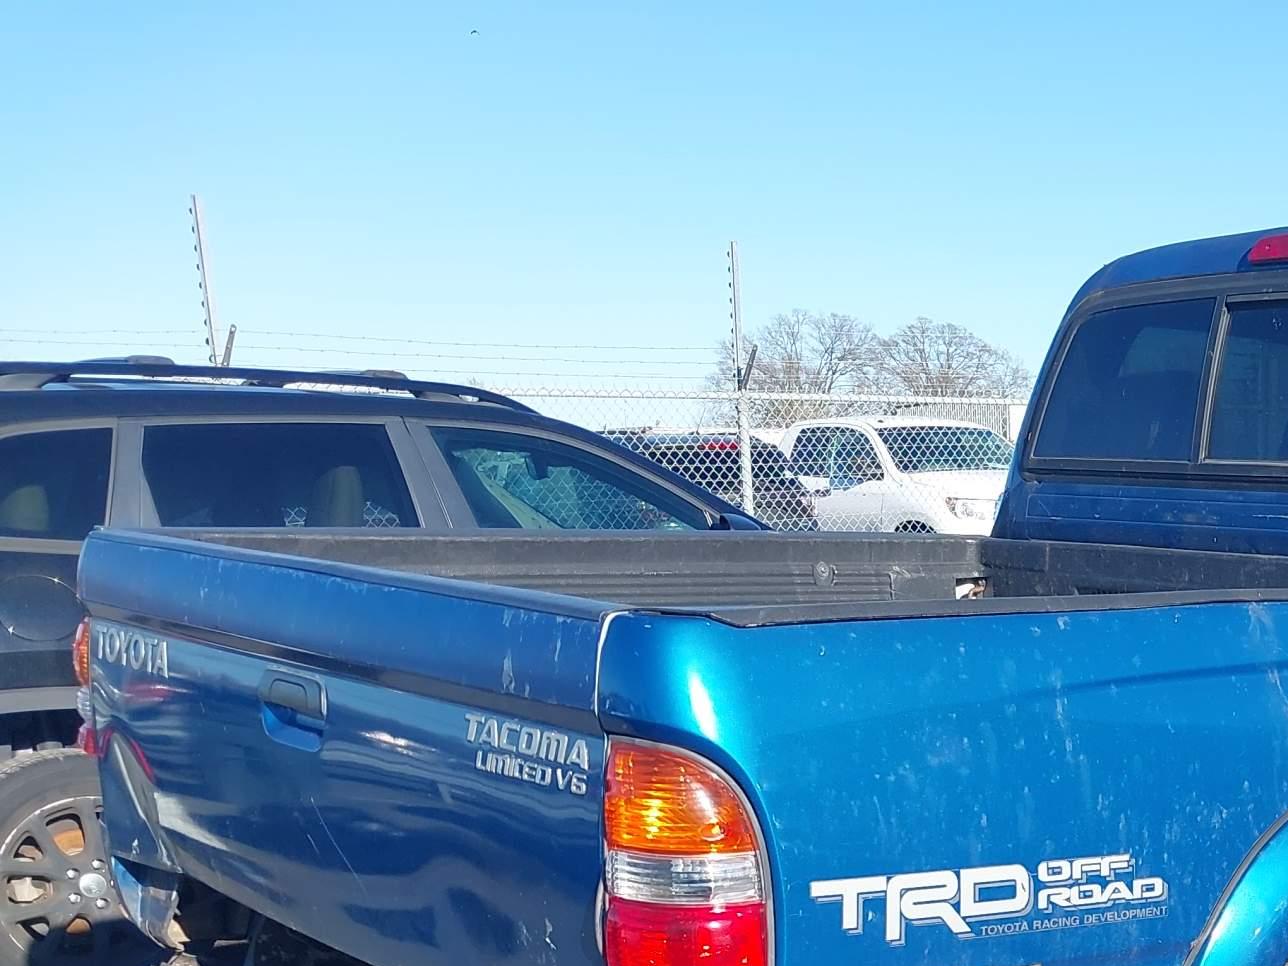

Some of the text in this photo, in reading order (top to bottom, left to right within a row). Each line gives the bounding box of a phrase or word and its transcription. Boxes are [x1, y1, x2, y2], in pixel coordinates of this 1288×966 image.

[96, 625, 168, 678] TOYOTA
[464, 713, 589, 771] TACOMA
[475, 751, 588, 795] LIMITED V6
[1037, 854, 1135, 883] OFF
[809, 863, 1034, 946] TRD
[1037, 877, 1167, 911] ROAD
[980, 906, 1168, 937] TOYOTA RACING DEVELOPMENT
